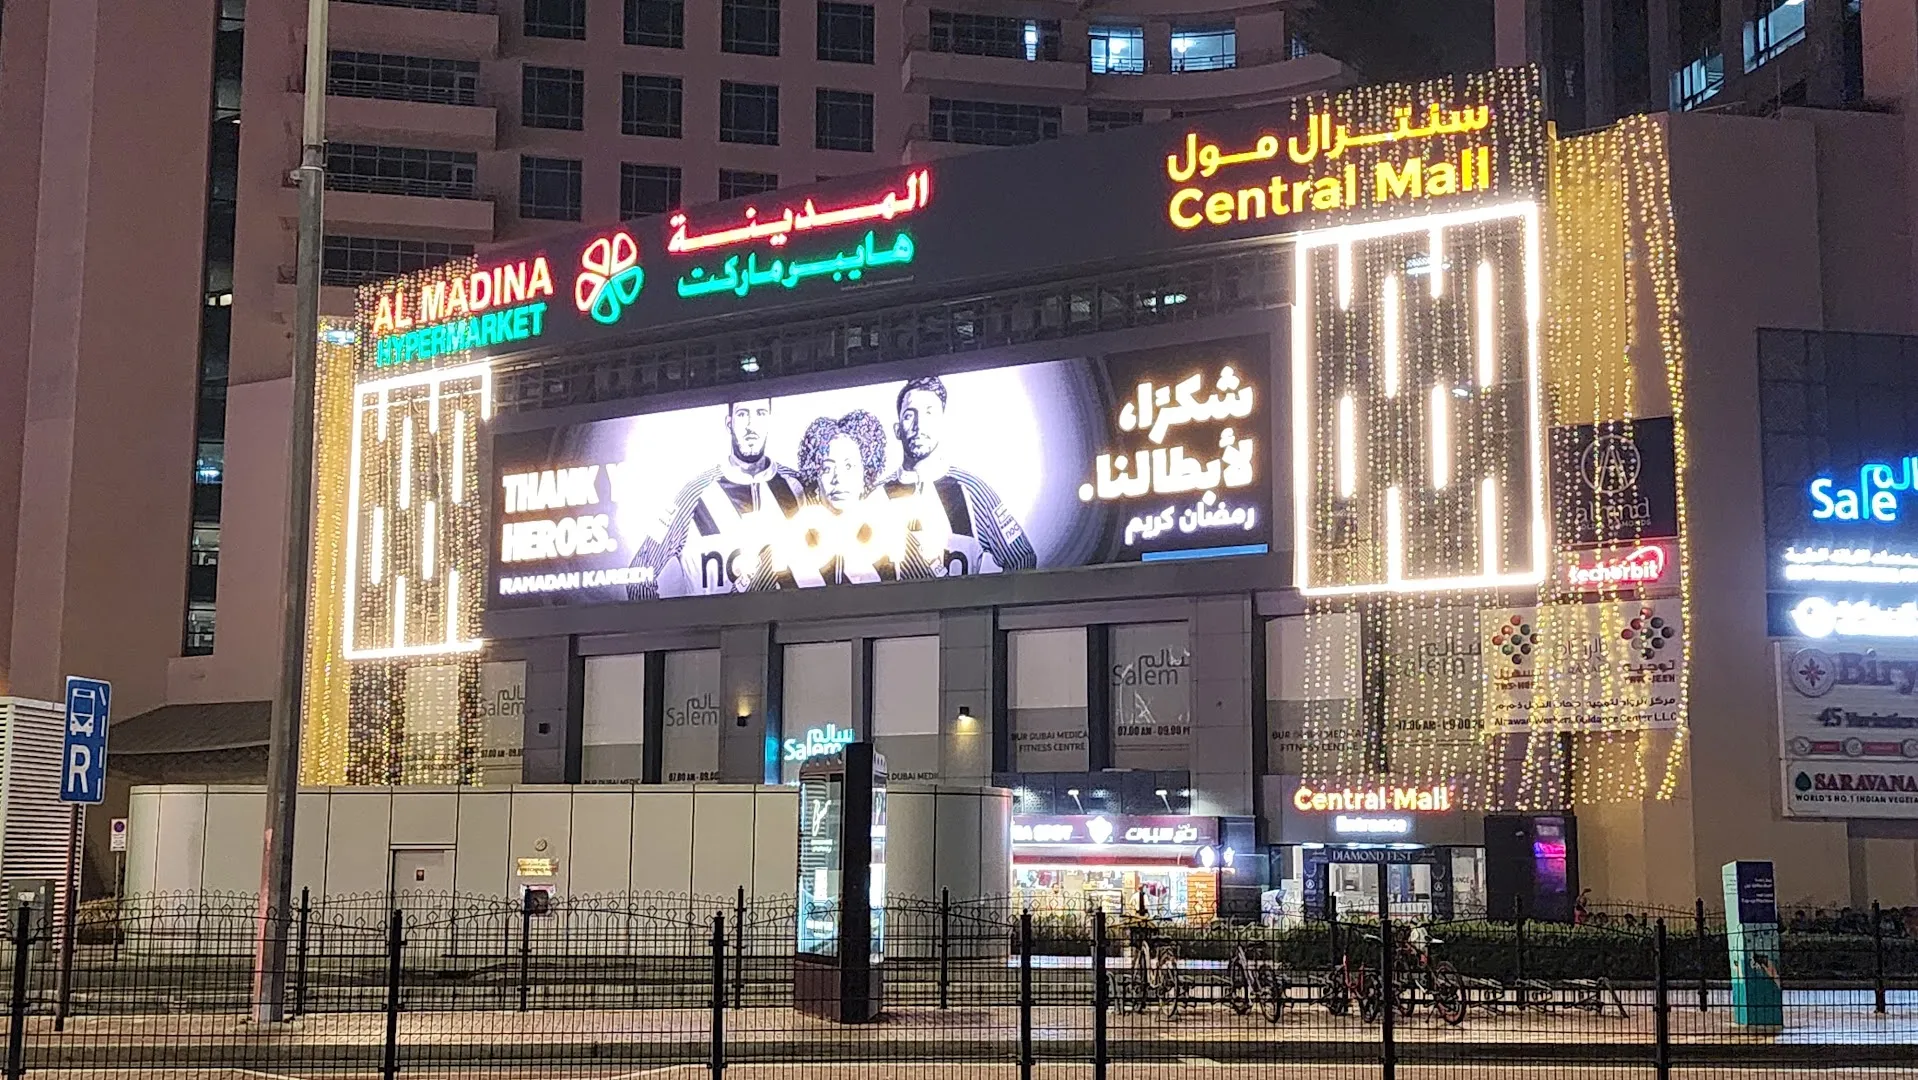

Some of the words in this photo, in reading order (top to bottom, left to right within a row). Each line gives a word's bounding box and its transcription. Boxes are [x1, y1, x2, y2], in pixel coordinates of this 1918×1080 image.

[1167, 133, 1279, 183] مول
[1287, 103, 1489, 164] سنترال
[667, 169, 930, 253] المدينة
[1168, 164, 1356, 230] Central
[1376, 146, 1490, 203] Mall
[373, 287, 413, 335] AL
[416, 256, 554, 324] MADINA
[381, 302, 548, 368] HYPERMARKET
[501, 464, 600, 514] THANK
[1113, 664, 1178, 686] Salem
[666, 708, 718, 727] Salem
[67, 744, 91, 793] R
[1293, 786, 1387, 811] Central
[1393, 786, 1451, 811] Mall
[1332, 850, 1384, 861] DIAMOND
